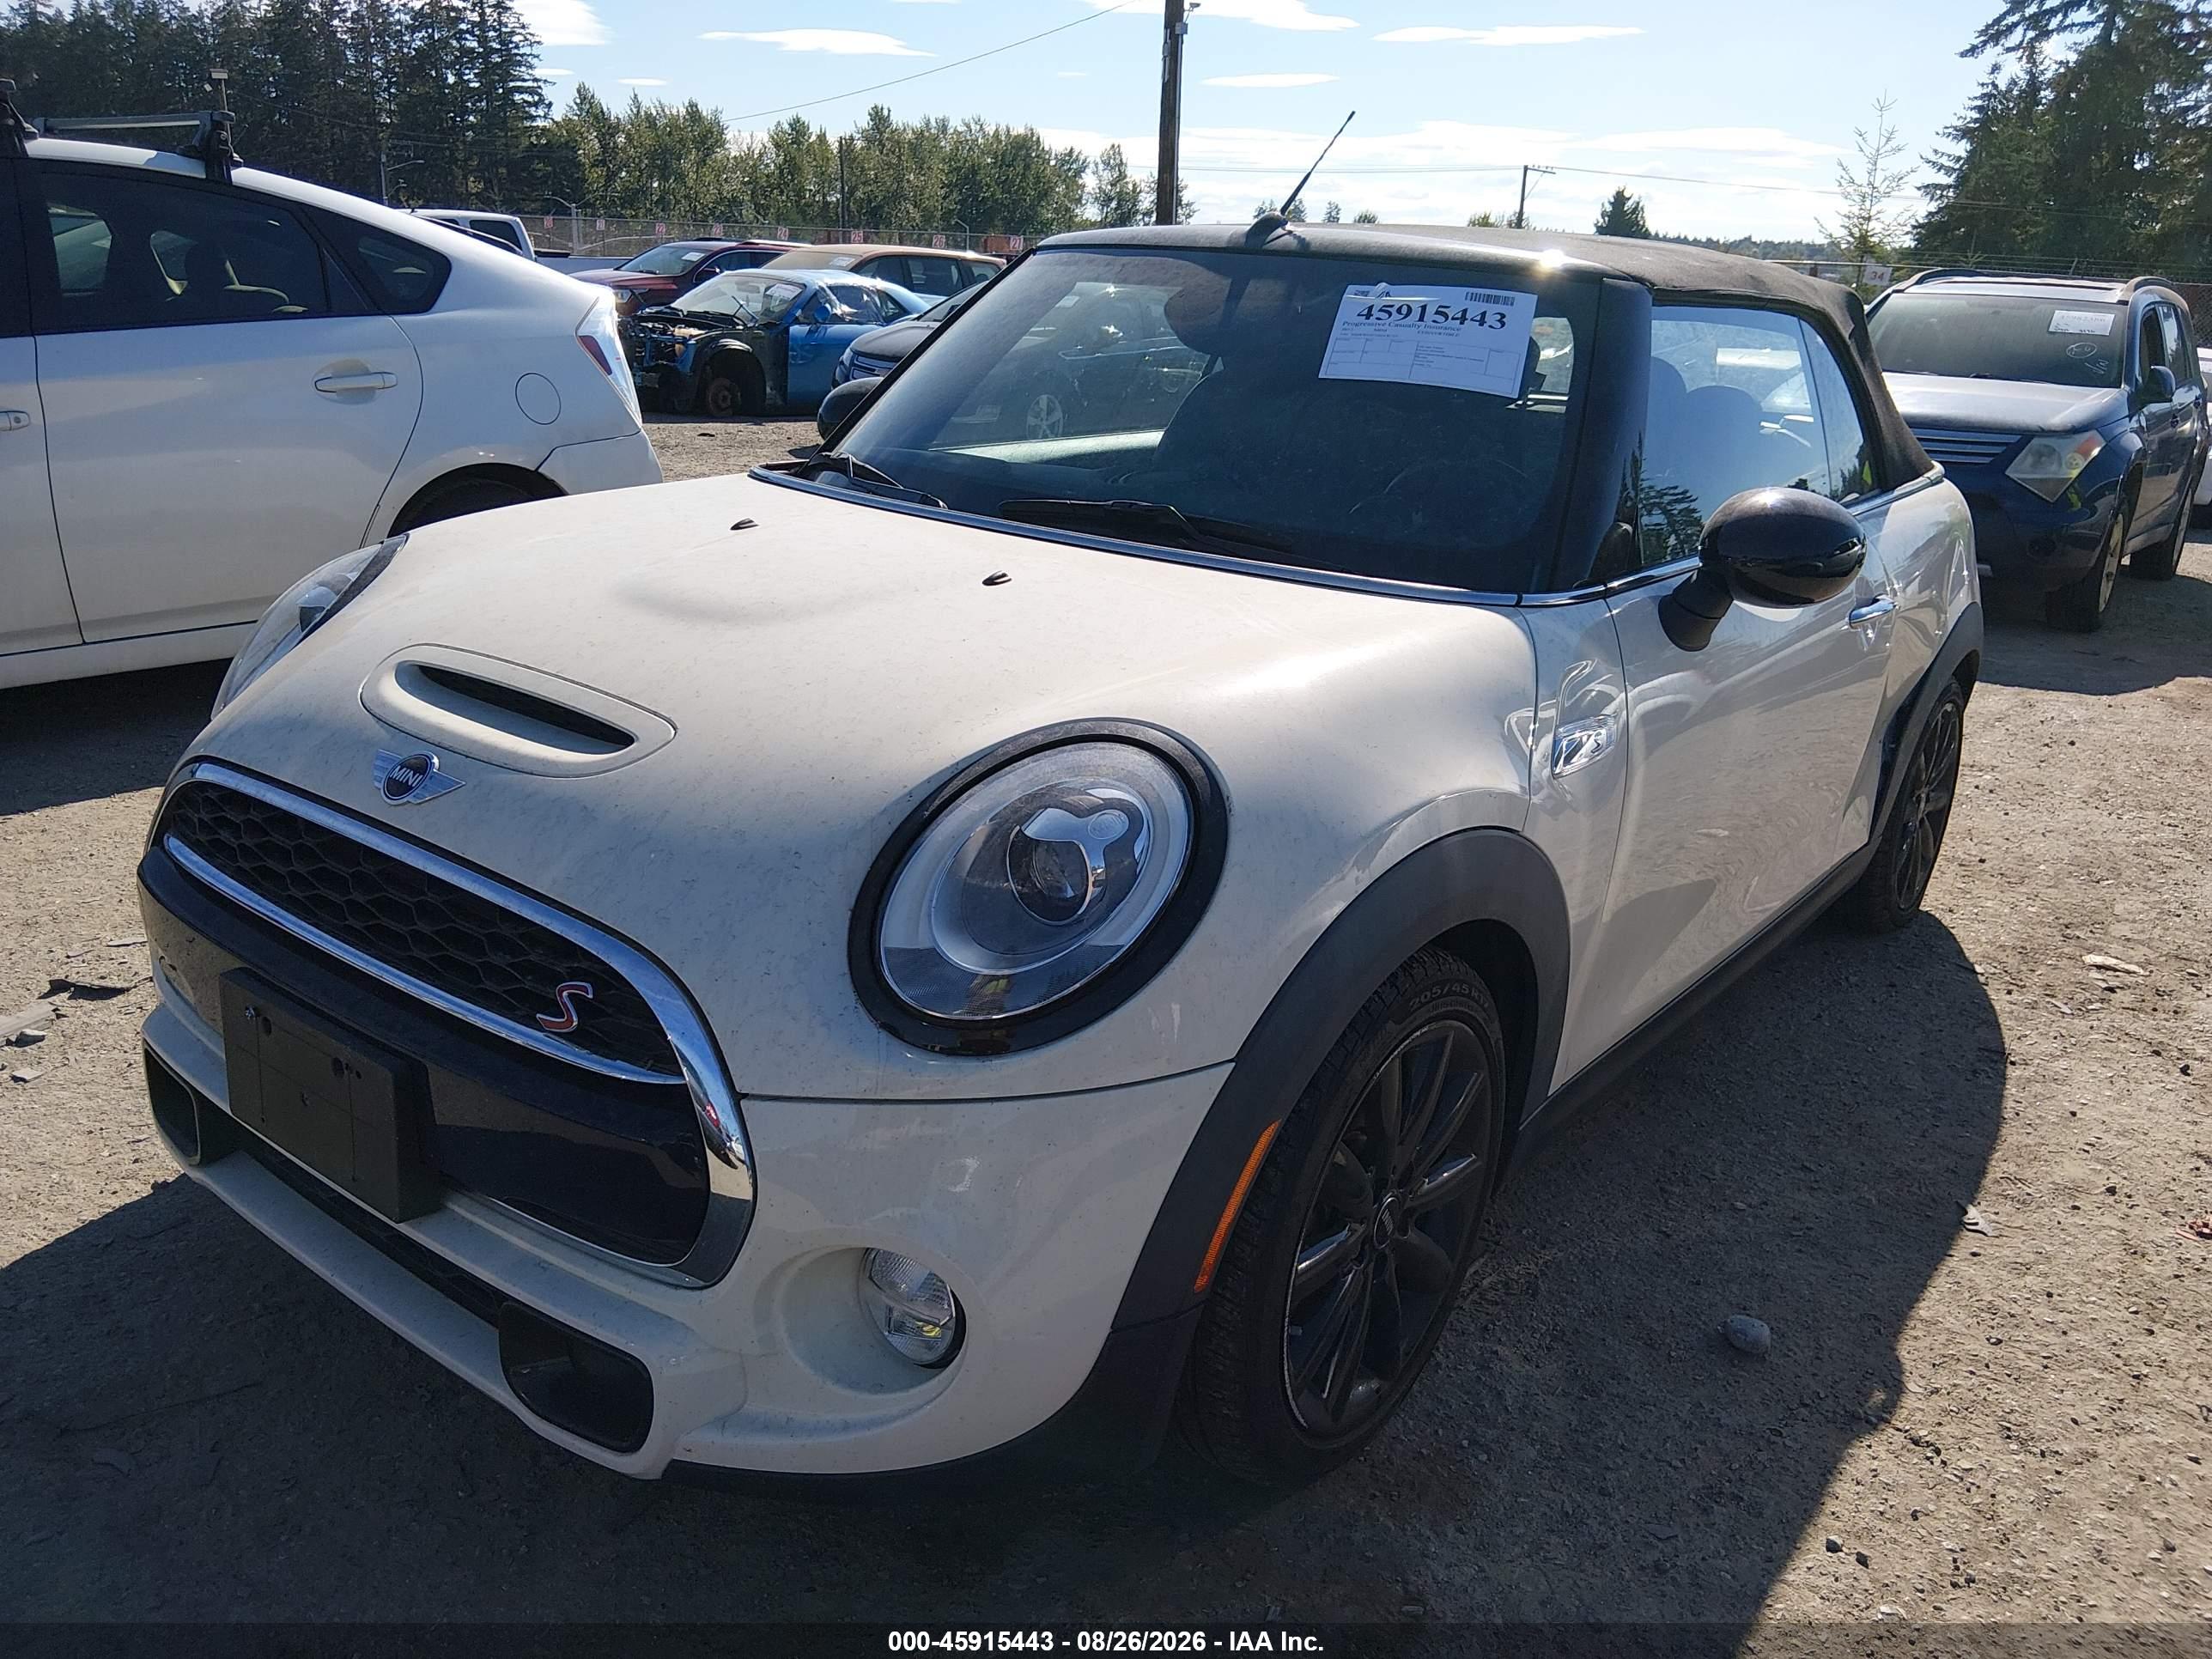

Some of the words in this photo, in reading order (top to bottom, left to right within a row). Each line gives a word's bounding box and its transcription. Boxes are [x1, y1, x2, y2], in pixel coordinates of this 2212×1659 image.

[778, 228, 788, 239] 24
[852, 232, 862, 243] 25
[933, 235, 944, 247] 26
[1012, 238, 1022, 250] 27
[1871, 270, 1884, 282] 34
[1357, 302, 1507, 330] 45915443
[1389, 321, 1421, 330] Casualty
[1424, 323, 1462, 331] Insurance
[390, 765, 423, 787] MINI
[536, 981, 593, 1033] S
